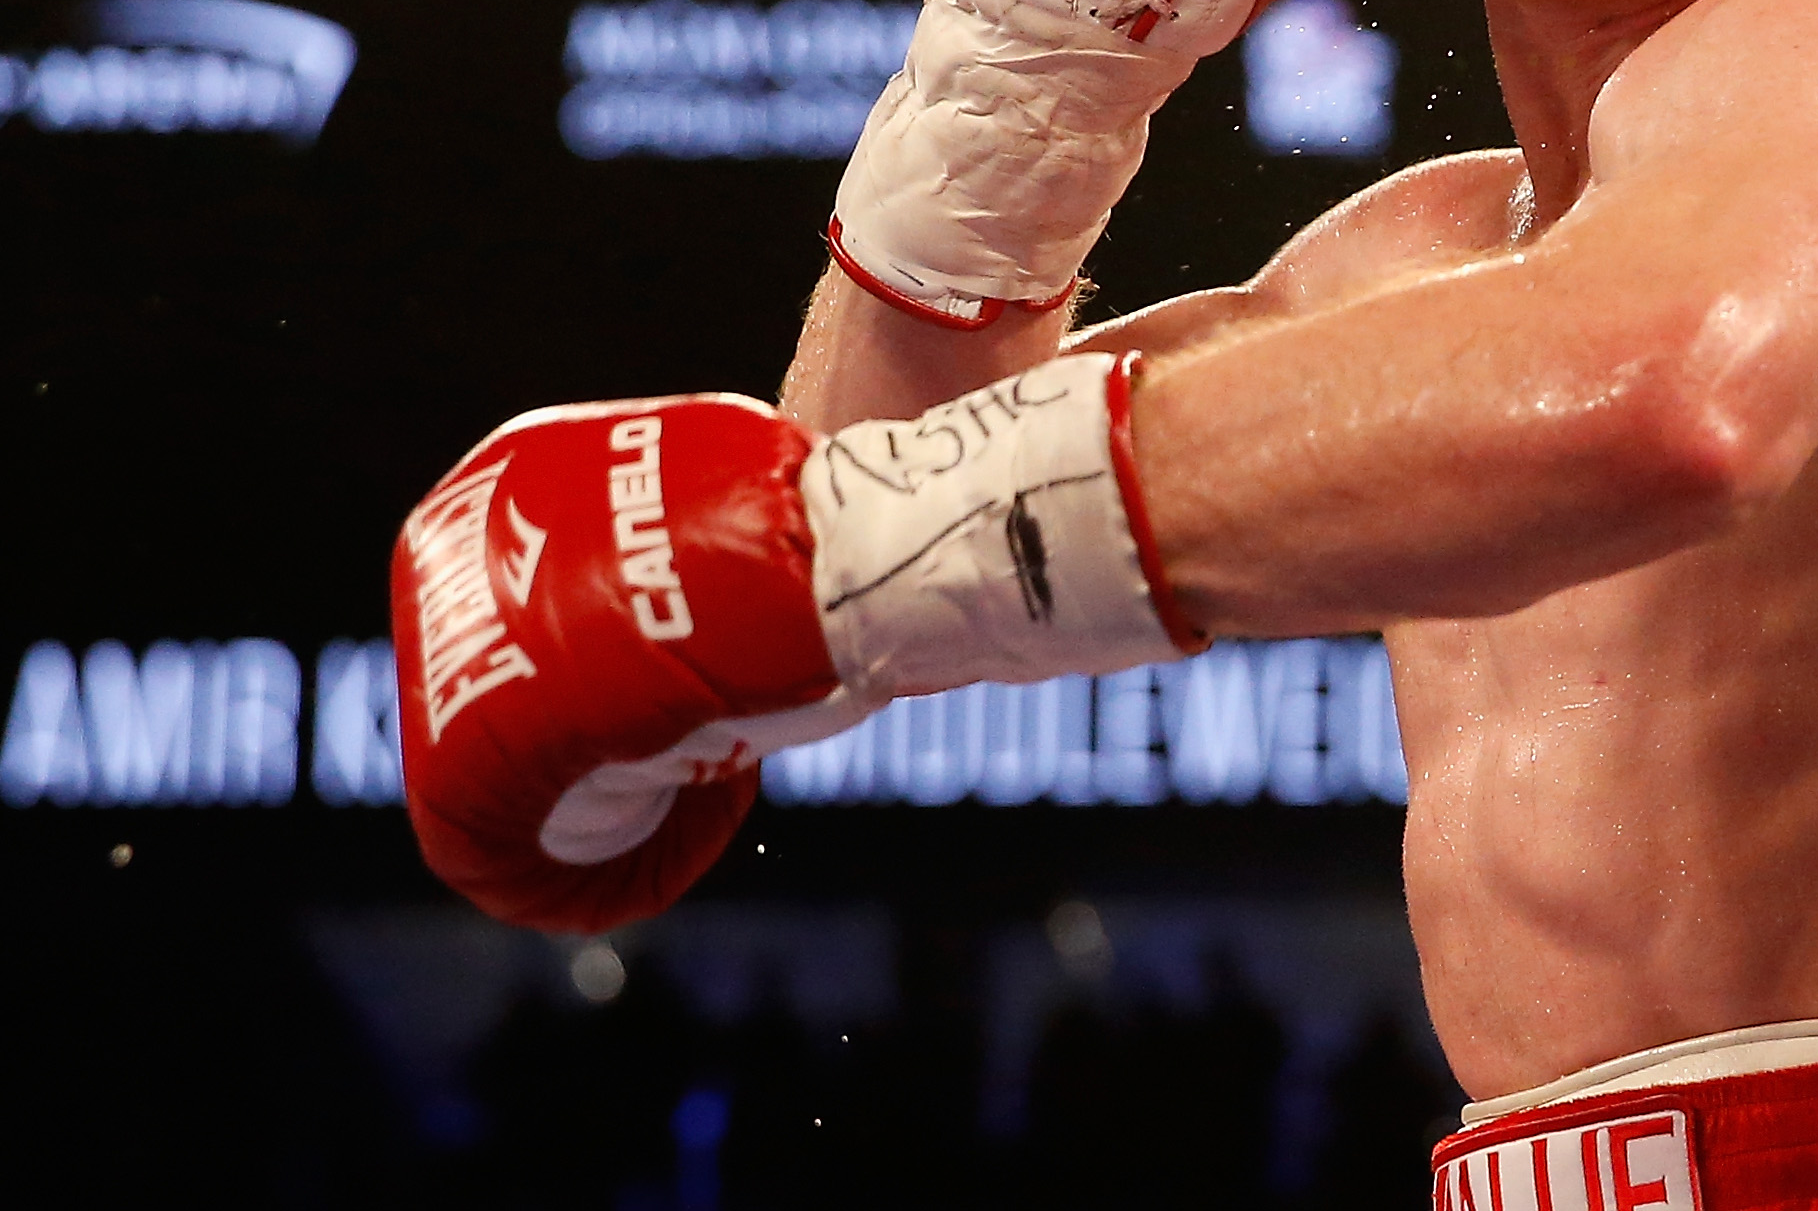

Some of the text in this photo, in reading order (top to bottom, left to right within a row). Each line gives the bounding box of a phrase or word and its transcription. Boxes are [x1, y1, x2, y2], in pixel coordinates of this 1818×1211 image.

[405, 449, 539, 746] EVERLAST
[609, 415, 696, 641] CANELO
[2, 638, 300, 808] AMIR
